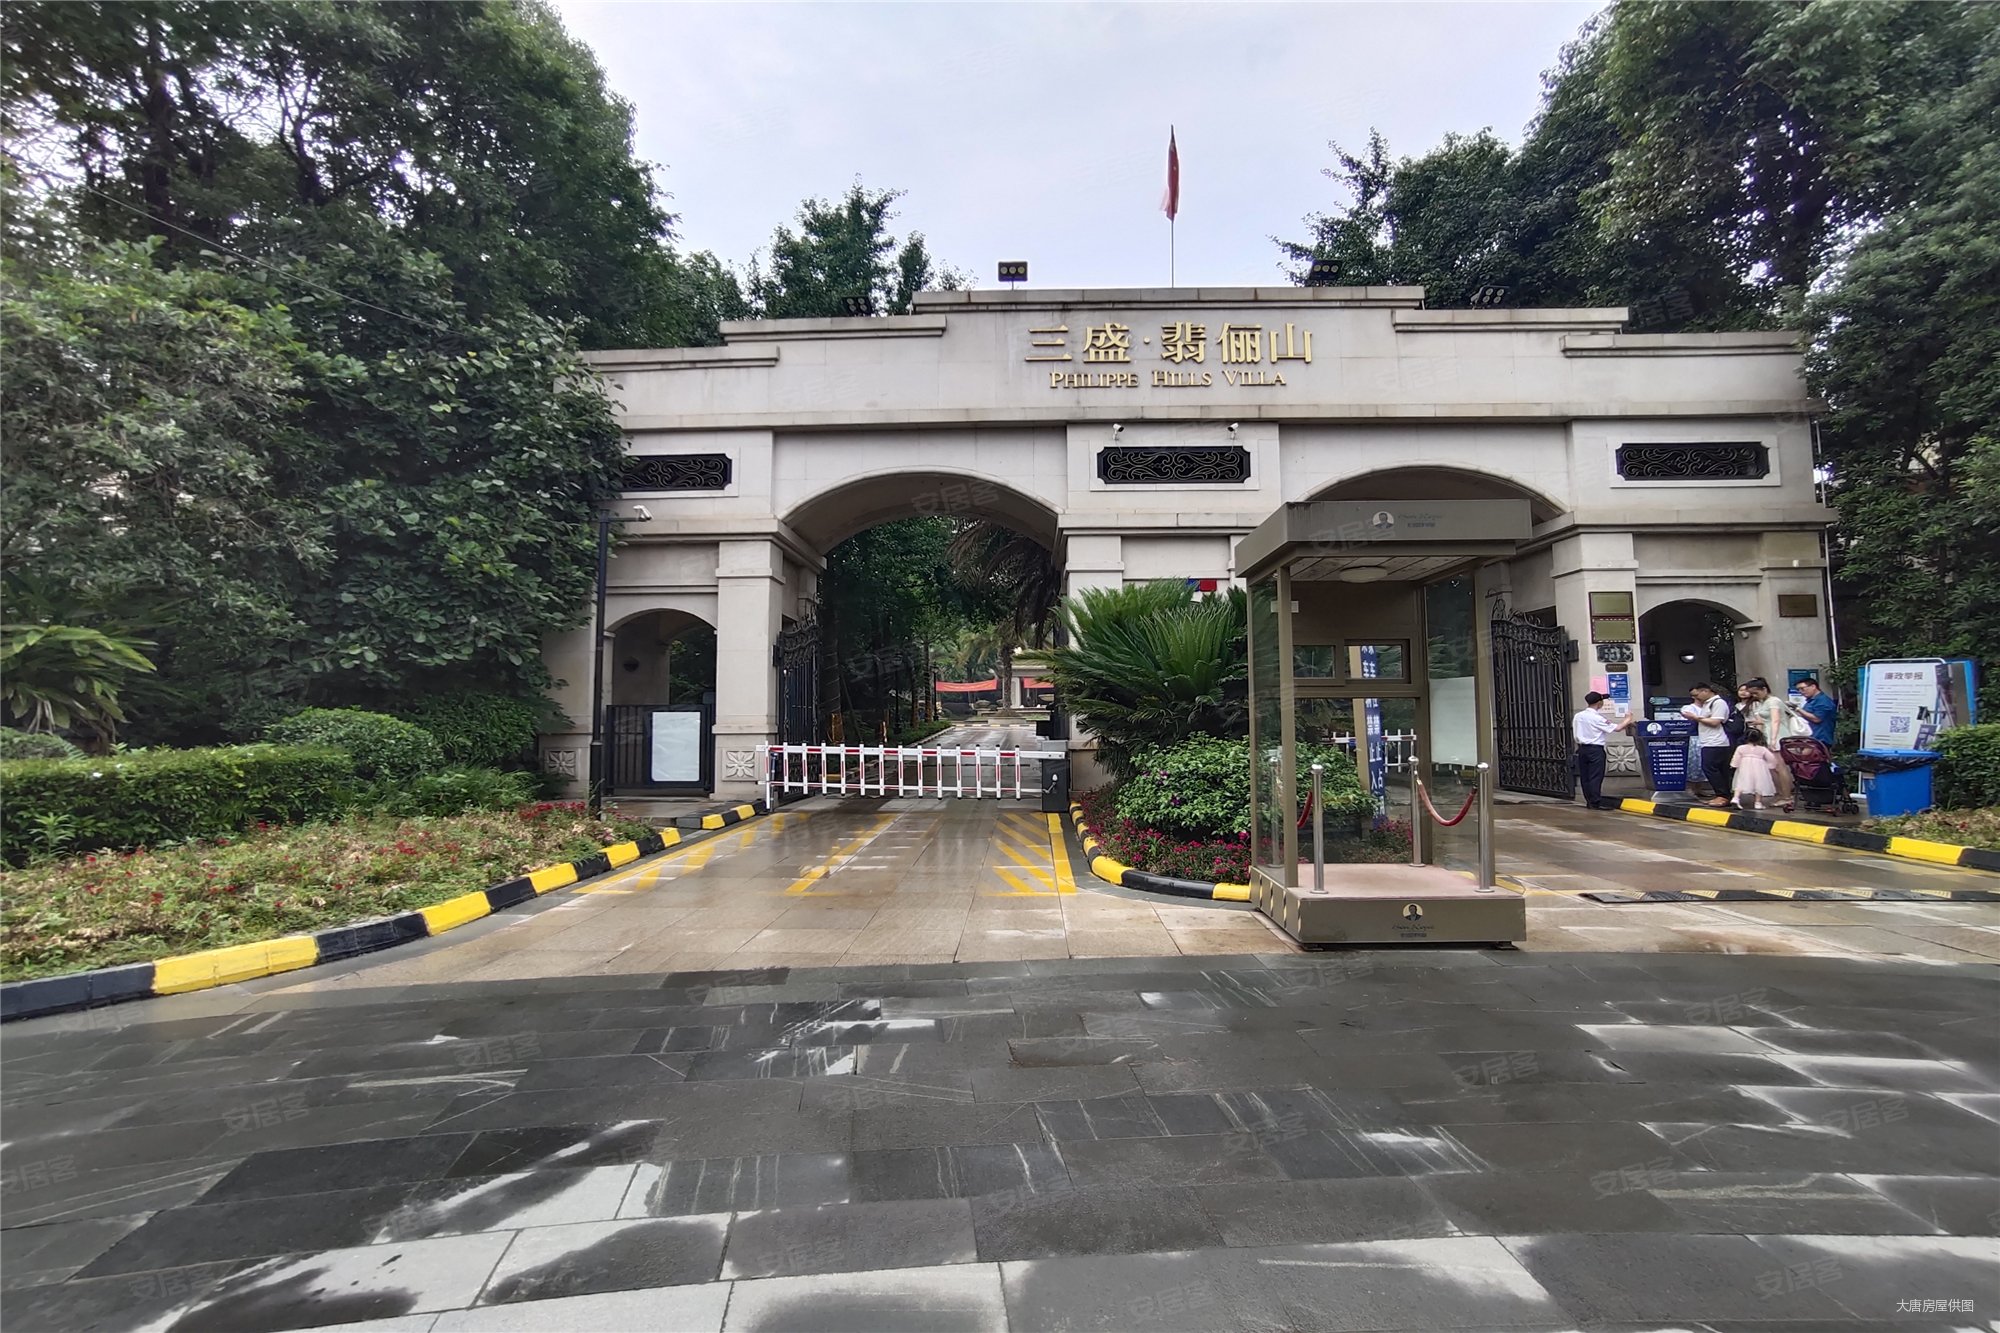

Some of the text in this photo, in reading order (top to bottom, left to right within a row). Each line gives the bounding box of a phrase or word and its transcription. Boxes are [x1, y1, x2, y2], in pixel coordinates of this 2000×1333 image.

[1025, 322, 1312, 364] 三盛·翡俪山
